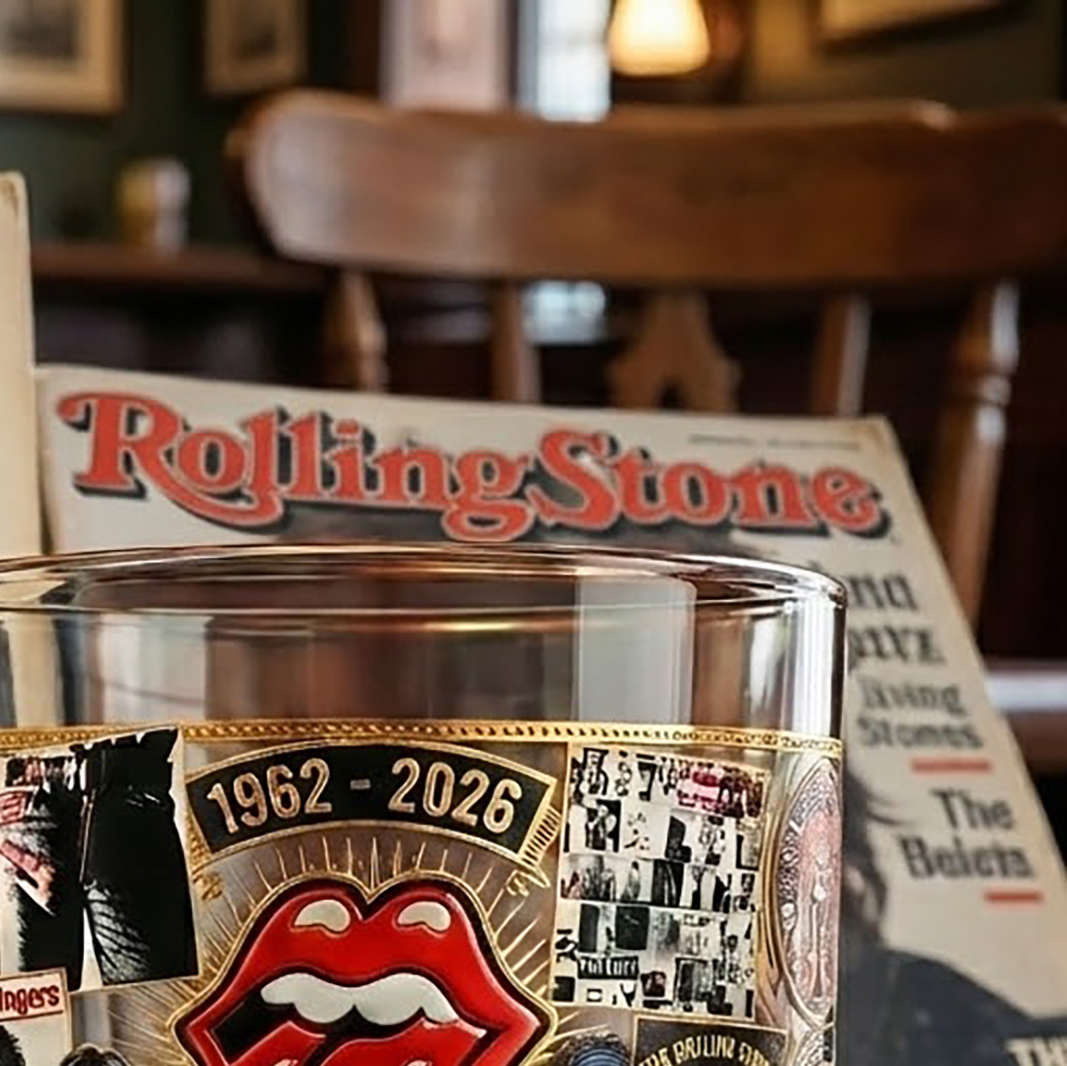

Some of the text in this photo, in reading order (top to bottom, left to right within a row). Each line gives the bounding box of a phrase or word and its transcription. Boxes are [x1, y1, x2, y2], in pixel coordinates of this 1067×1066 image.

[56, 391, 892, 543] Rolling Stone
[206, 757, 332, 834] 1962
[387, 757, 523, 833] 2026
[929, 787, 1016, 831] The
